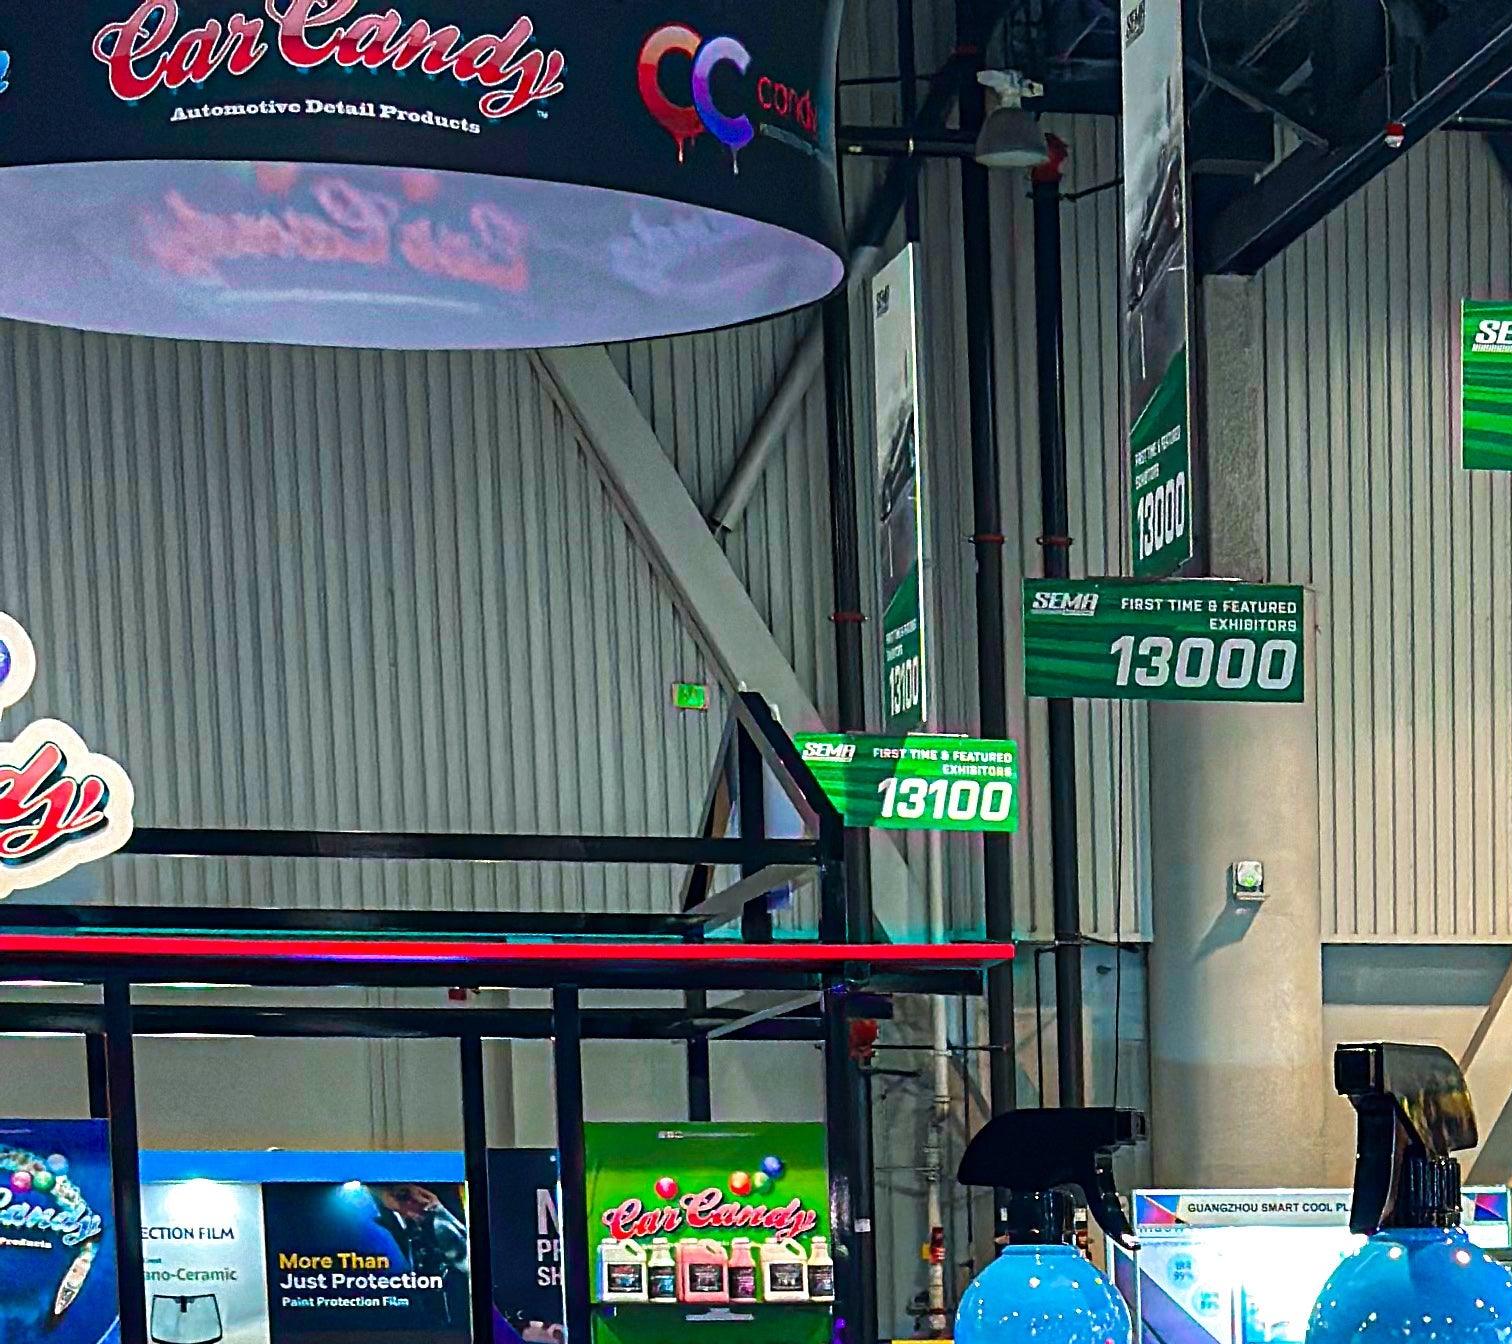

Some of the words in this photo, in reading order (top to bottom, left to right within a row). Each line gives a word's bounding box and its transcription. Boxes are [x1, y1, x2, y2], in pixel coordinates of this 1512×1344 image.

[93, 0, 268, 100] Car
[264, 0, 565, 118] Candy
[170, 101, 301, 123] Automotive
[304, 99, 376, 118] Detail
[379, 104, 482, 135] Products
[1137, 470, 1185, 560] 13000
[1032, 592, 1099, 610] SEMA
[1121, 598, 1162, 611] FIRST
[1168, 599, 1203, 612] TIME
[1222, 600, 1297, 614] FEATURED
[1209, 618, 1297, 632] EXHIBITORS
[1110, 635, 1297, 690] 13000
[803, 742, 856, 757] SEMA
[873, 748, 906, 759] FIRST
[909, 750, 937, 761] TIME
[952, 751, 1013, 764] FEATURED
[942, 764, 1012, 777] EXHIBITORS
[877, 777, 1013, 821] 13100
[603, 1199, 682, 1240] Car
[678, 1187, 817, 1242] Candy
[1187, 1202, 1258, 1213] GUANGZHOU
[1261, 1202, 1299, 1212] SMART
[1302, 1202, 1333, 1212] COOL
[1335, 1203, 1351, 1212] PL
[198, 1227, 235, 1240] FILM
[278, 1252, 333, 1270] More
[337, 1251, 390, 1270] Than
[279, 1273, 327, 1289] Just
[332, 1272, 443, 1290] Protection
[281, 1297, 315, 1307] Paint
[316, 1297, 380, 1307] Protection
[382, 1296, 409, 1307] Film
